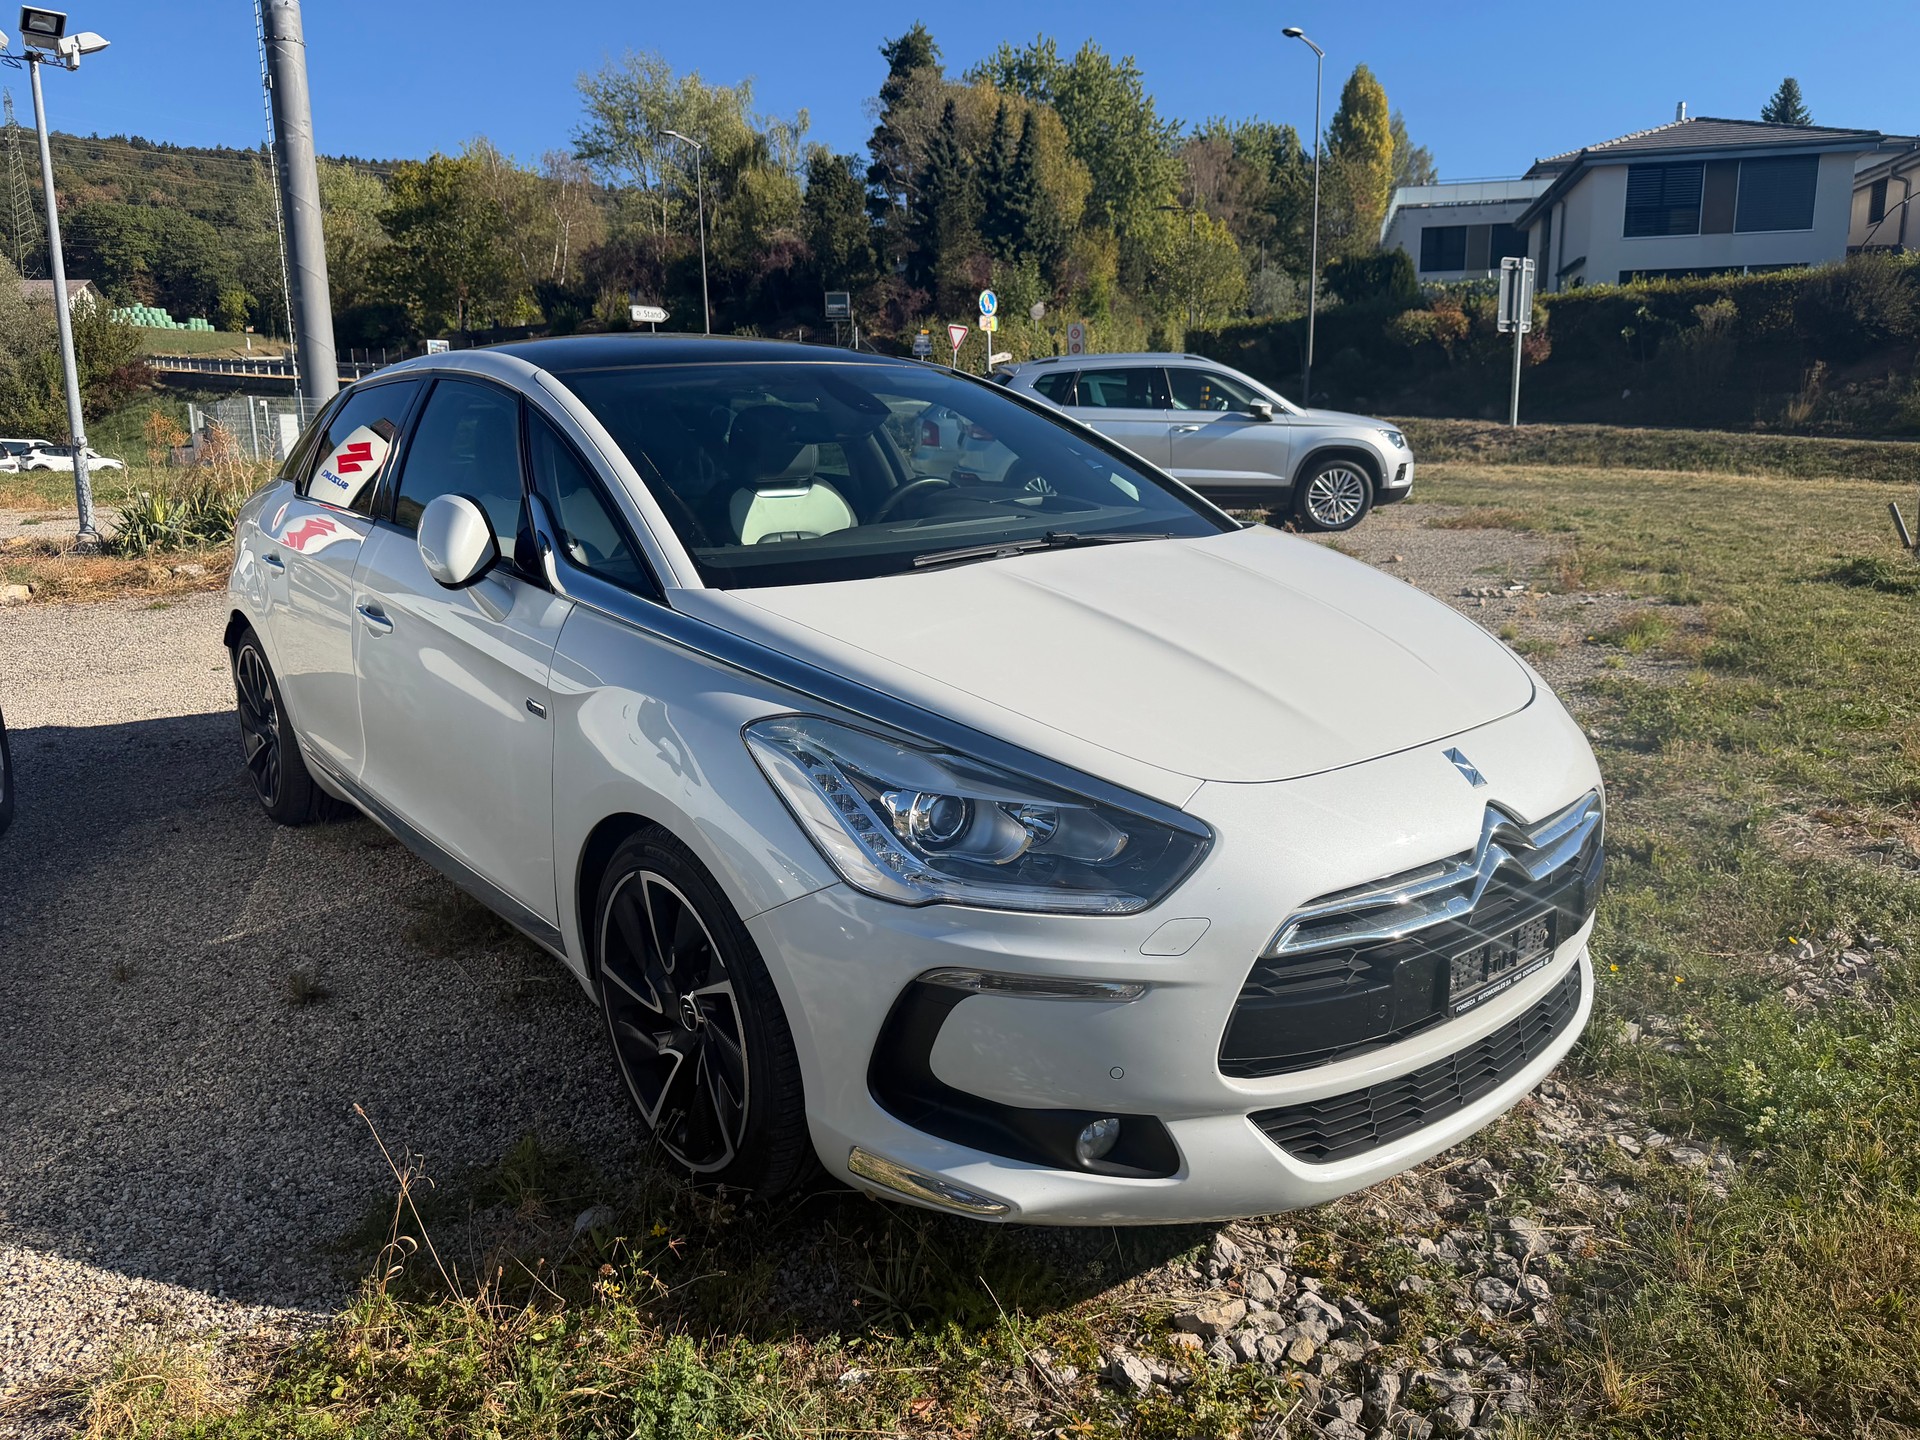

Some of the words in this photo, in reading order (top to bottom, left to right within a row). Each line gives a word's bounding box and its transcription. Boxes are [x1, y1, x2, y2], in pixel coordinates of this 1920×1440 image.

[643, 309, 662, 319] Stand
[1456, 998, 1476, 1012] FONSECA
[1478, 983, 1506, 1001] AUTOMOBILES
[1523, 960, 1544, 977] DOMPIERRE
